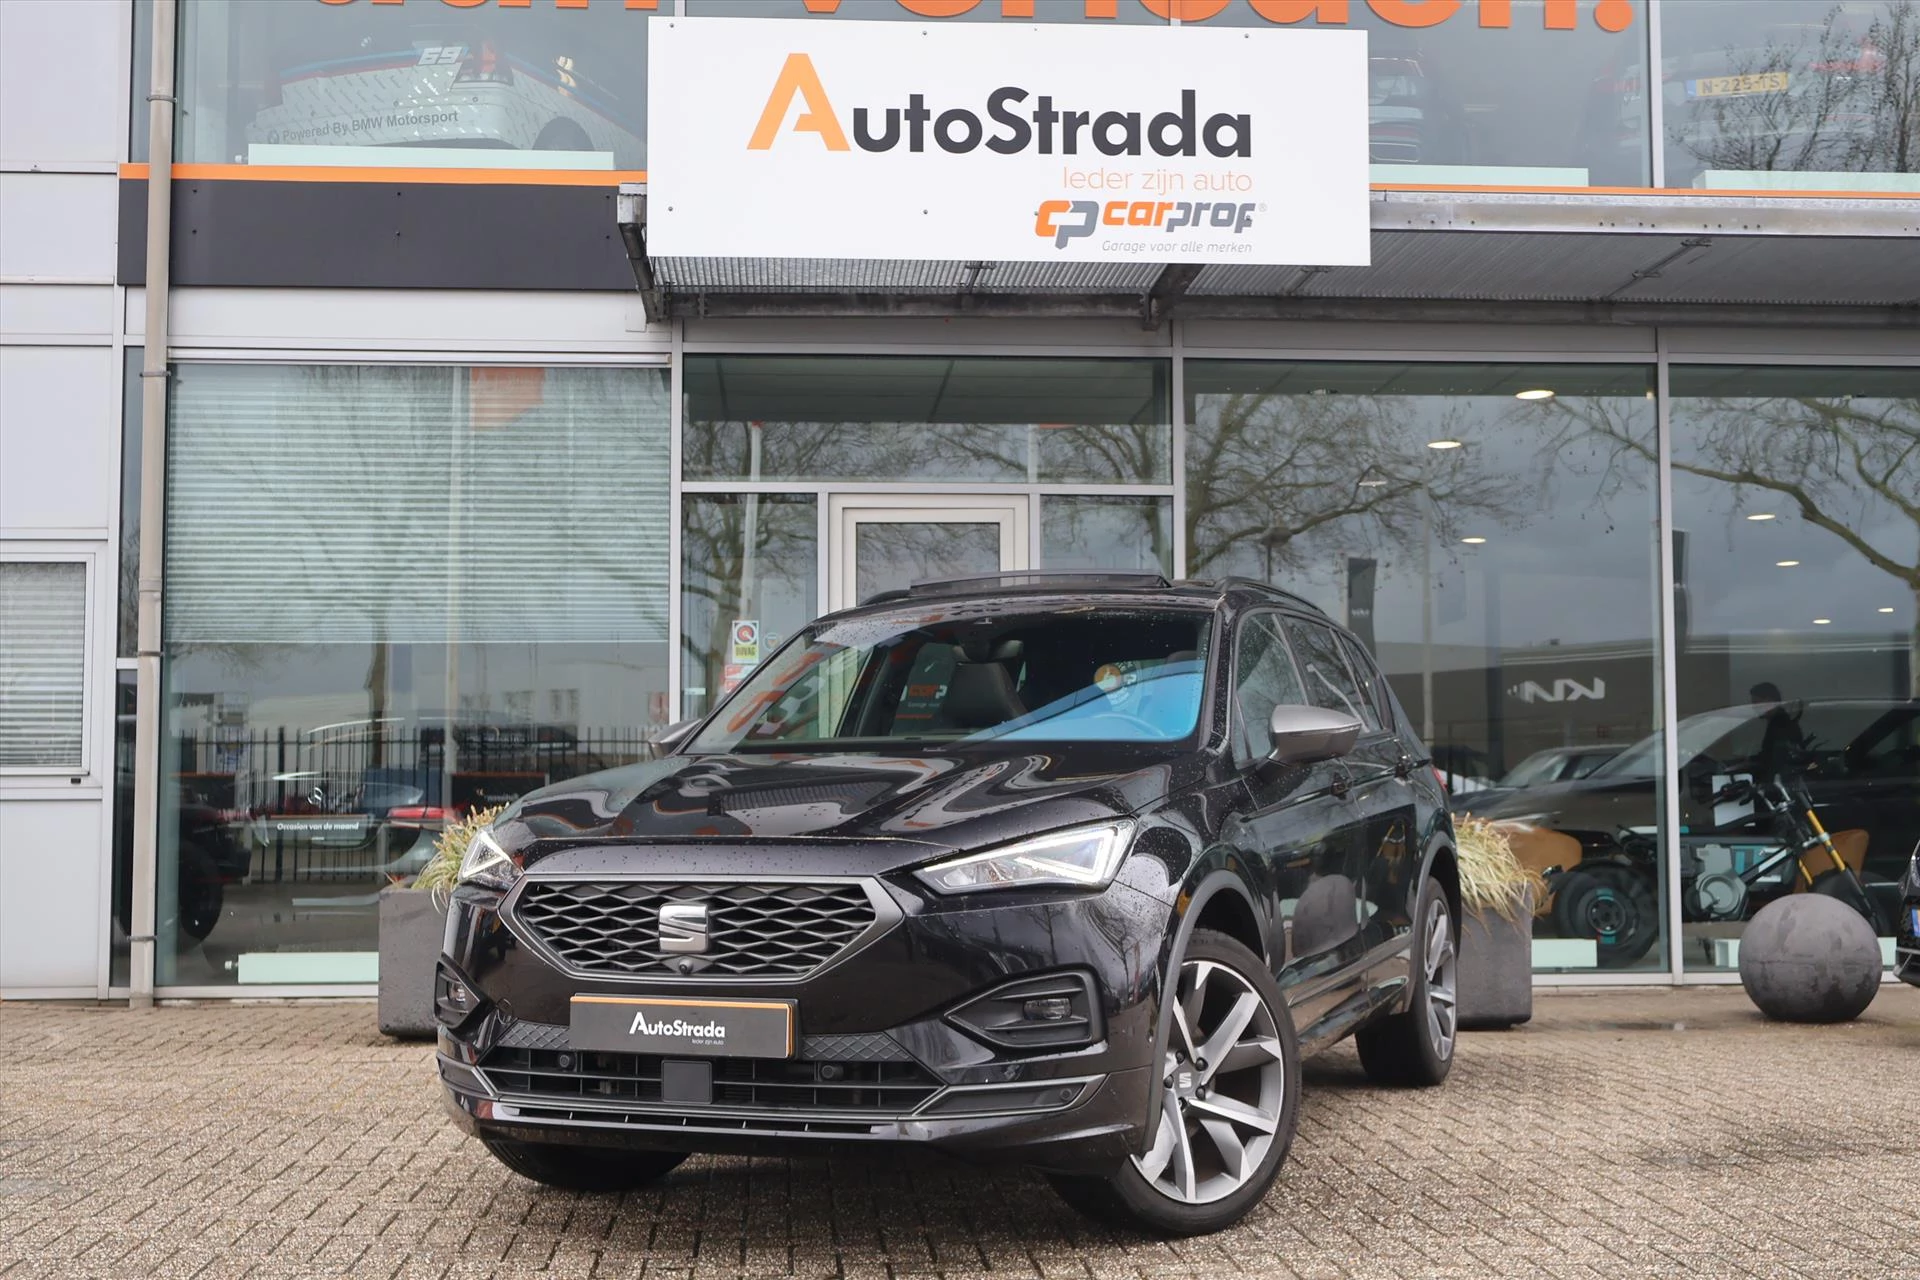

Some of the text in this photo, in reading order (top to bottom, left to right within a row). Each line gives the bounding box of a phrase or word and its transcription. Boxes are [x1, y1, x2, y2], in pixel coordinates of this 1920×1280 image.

[417, 46, 463, 66] 69
[746, 52, 1252, 158] AutoStrada
[283, 110, 459, 141] Powered By BMW Motorsport
[1063, 167, 1253, 196] Ieder zijn auto
[1102, 201, 1257, 234] carprof
[1102, 240, 1253, 254] Garage voor alle merken
[277, 822, 360, 831] Occasion van de maand
[629, 1011, 726, 1038] AutoStrada
